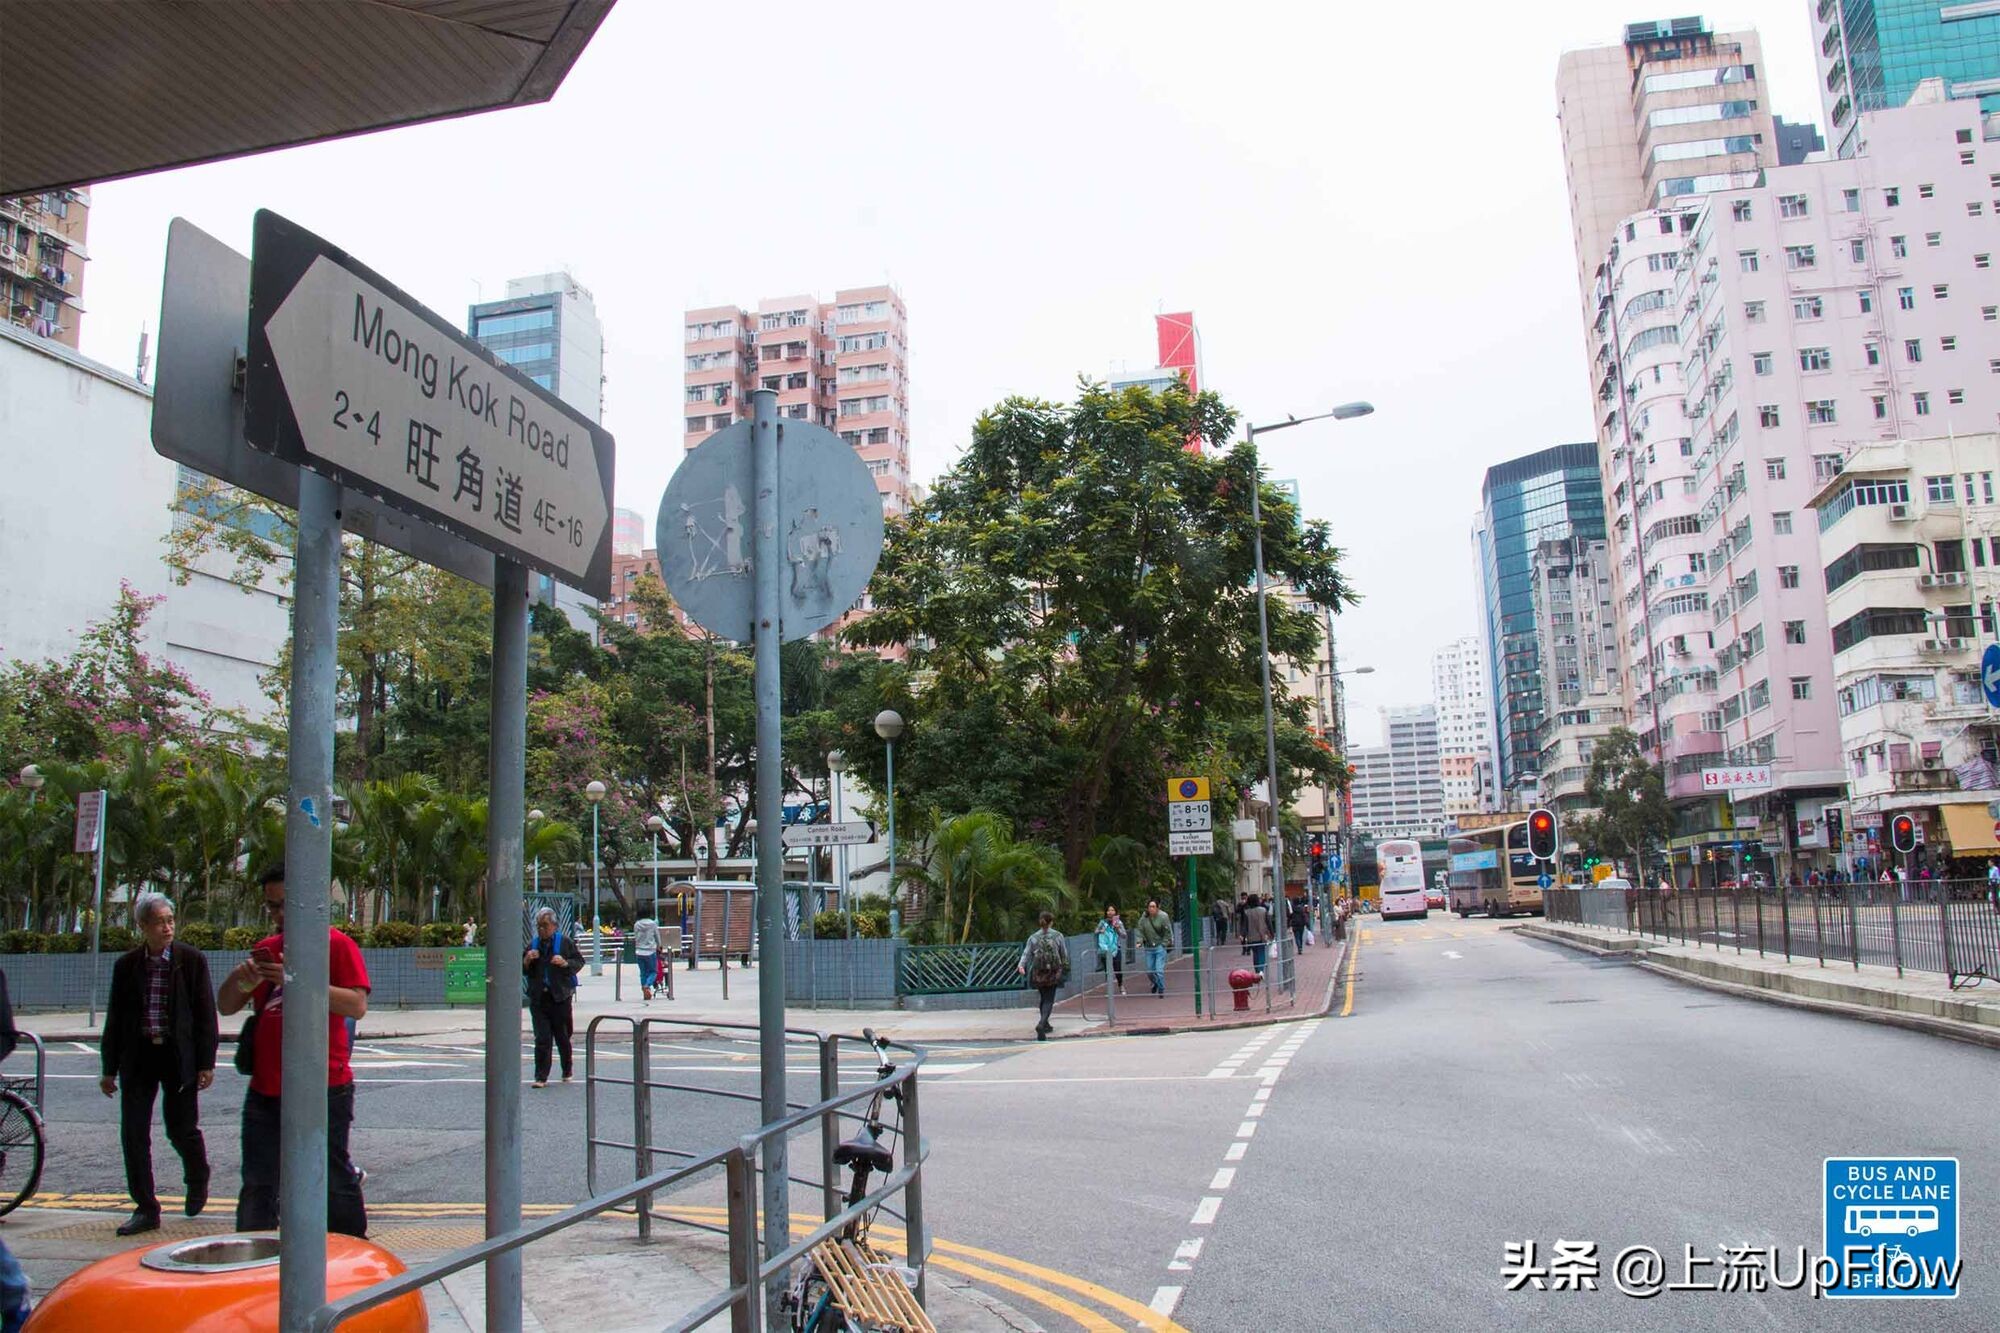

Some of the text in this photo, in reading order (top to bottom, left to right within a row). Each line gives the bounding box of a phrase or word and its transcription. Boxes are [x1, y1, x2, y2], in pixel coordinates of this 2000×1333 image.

[353, 292, 570, 470] Mong Kok Road
[405, 418, 523, 535] 旺角道
[1185, 804, 1209, 814] 8-10
